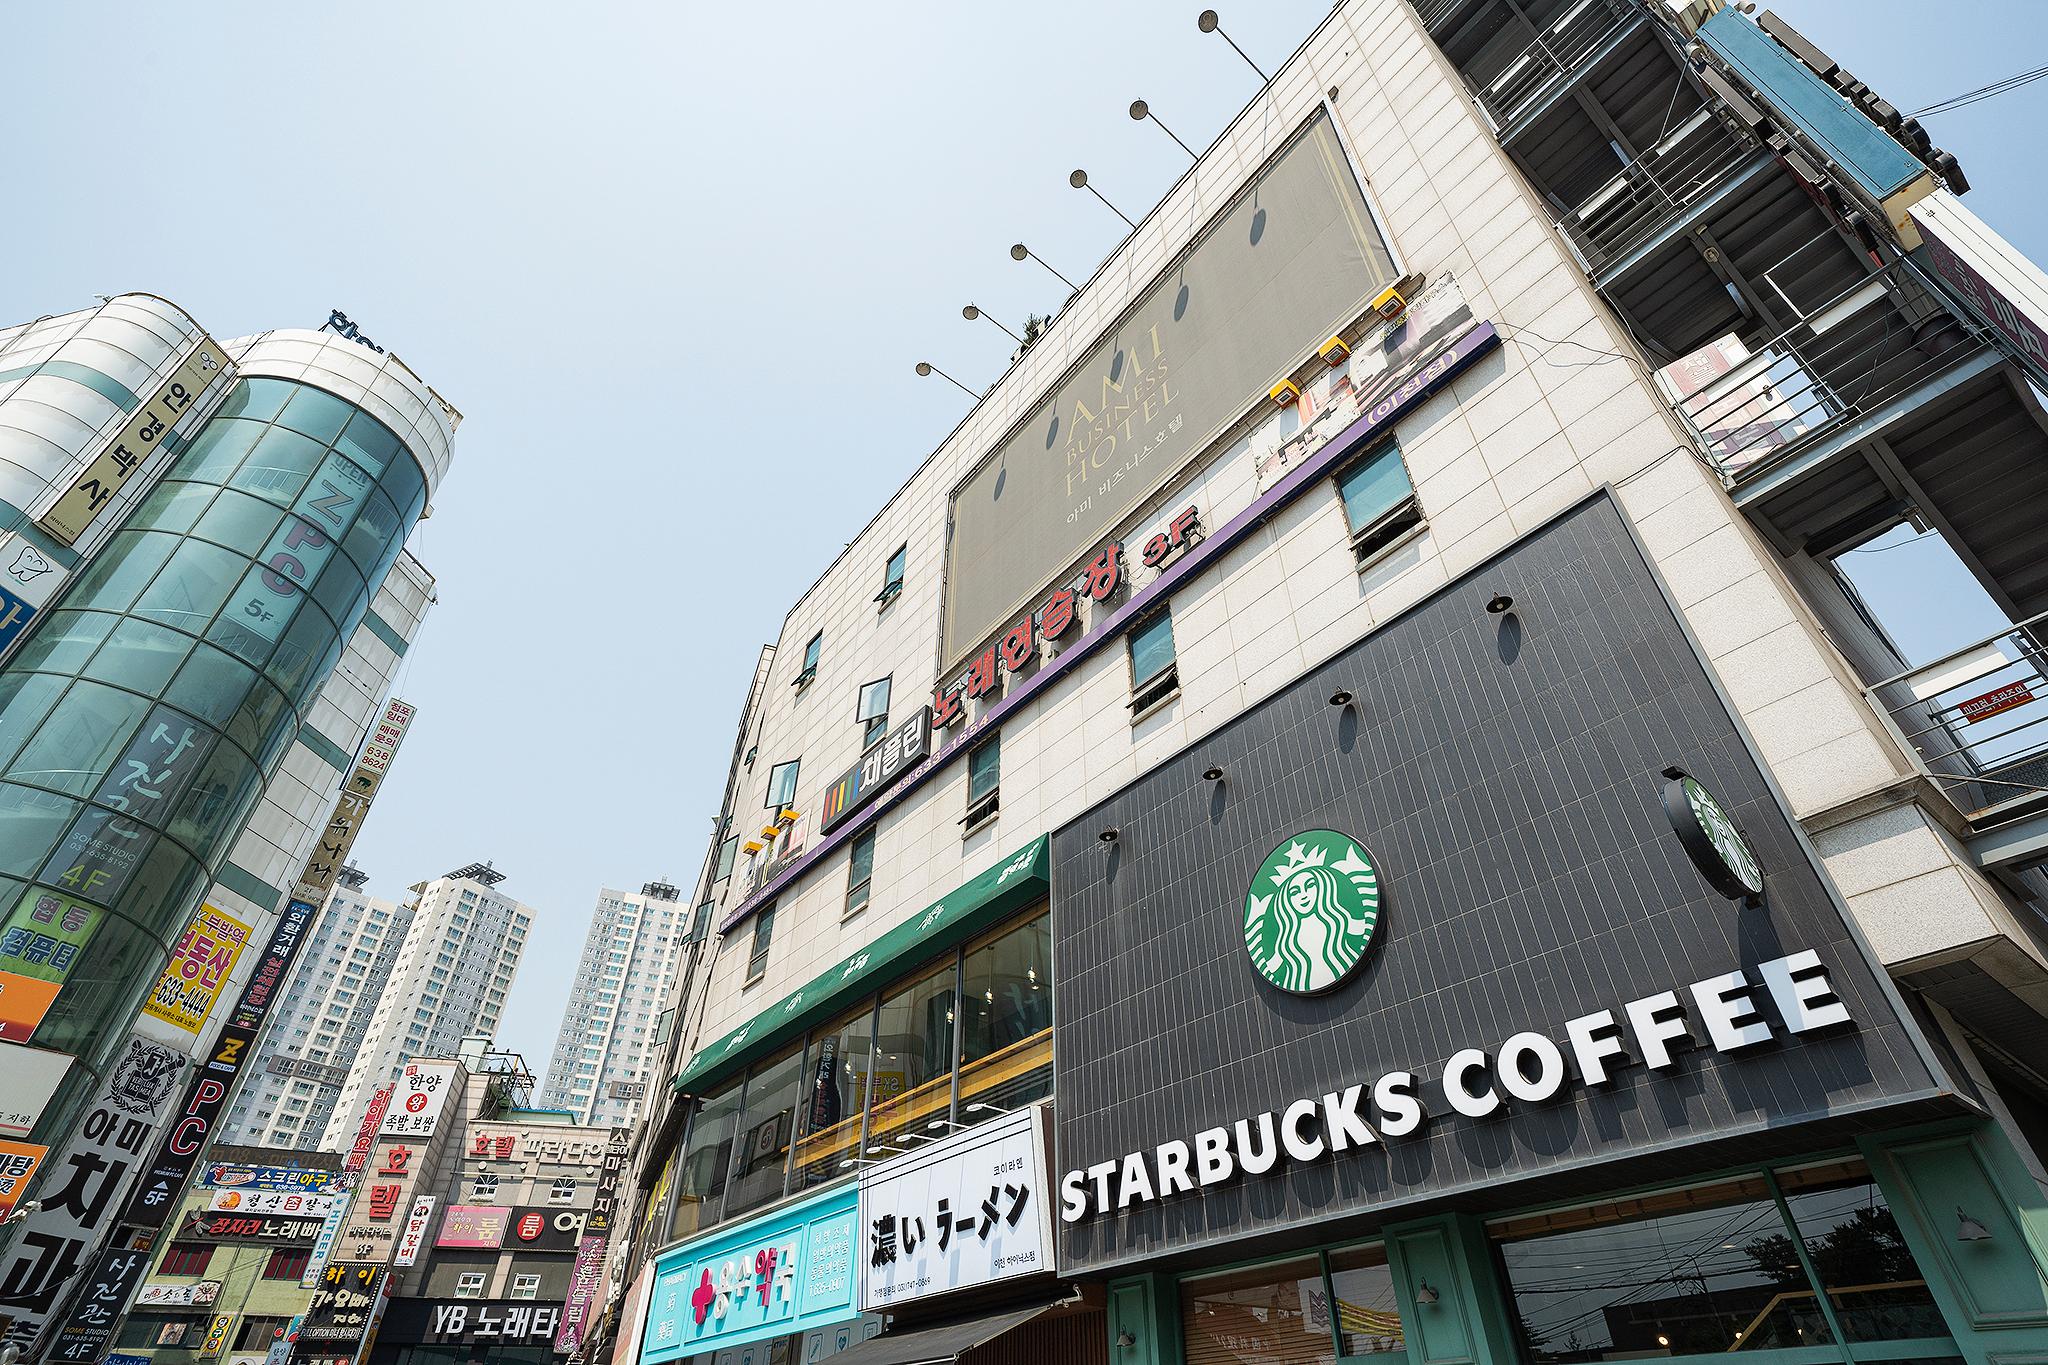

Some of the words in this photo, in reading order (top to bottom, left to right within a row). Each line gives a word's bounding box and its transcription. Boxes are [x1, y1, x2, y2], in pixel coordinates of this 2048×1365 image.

[1064, 321, 1168, 448] AMI
[1066, 357, 1168, 466] BUSINESS
[78, 382, 192, 512] 안경박사
[1065, 379, 1180, 497] HOTEL
[1067, 496, 1092, 523] 아미
[244, 599, 274, 623] 5F
[932, 540, 1125, 730] 노래연습장
[1143, 505, 1200, 567] 3F
[386, 710, 406, 725] 임대
[390, 701, 411, 716] 점포
[374, 732, 397, 748] 문의
[380, 723, 401, 738] 매매
[362, 755, 386, 771] 8624
[367, 746, 389, 761] 638
[72, 832, 103, 852] SOME
[103, 842, 136, 863] STUDIO
[61, 866, 113, 894] 4F
[206, 913, 245, 947] 부발역
[1, 925, 78, 973] 컴퓨터
[159, 977, 213, 1018] 633-4444
[409, 1073, 442, 1092] 한양
[1060, 1070, 1426, 1224] STARBUCKS
[1442, 949, 1853, 1118] COFFEE
[8, 1113, 30, 1125] 지하
[170, 1078, 225, 1155] PC
[83, 1109, 152, 1156] 아미
[469, 1135, 515, 1158] 호텔
[257, 1171, 329, 1187] 스크린야구
[994, 1157, 1023, 1176] 코이라멘
[369, 1145, 412, 1219] 호텔
[593, 1153, 621, 1213] 마사지
[145, 1190, 169, 1207] 5F
[400, 1218, 425, 1259] 닭갈비
[521, 1214, 541, 1238] 룸
[78, 1254, 137, 1324] 사진관
[64, 1326, 85, 1336] SOME
[85, 1327, 109, 1337] STUDIO
[434, 1305, 469, 1335] YB
[64, 1343, 93, 1359] 4F
